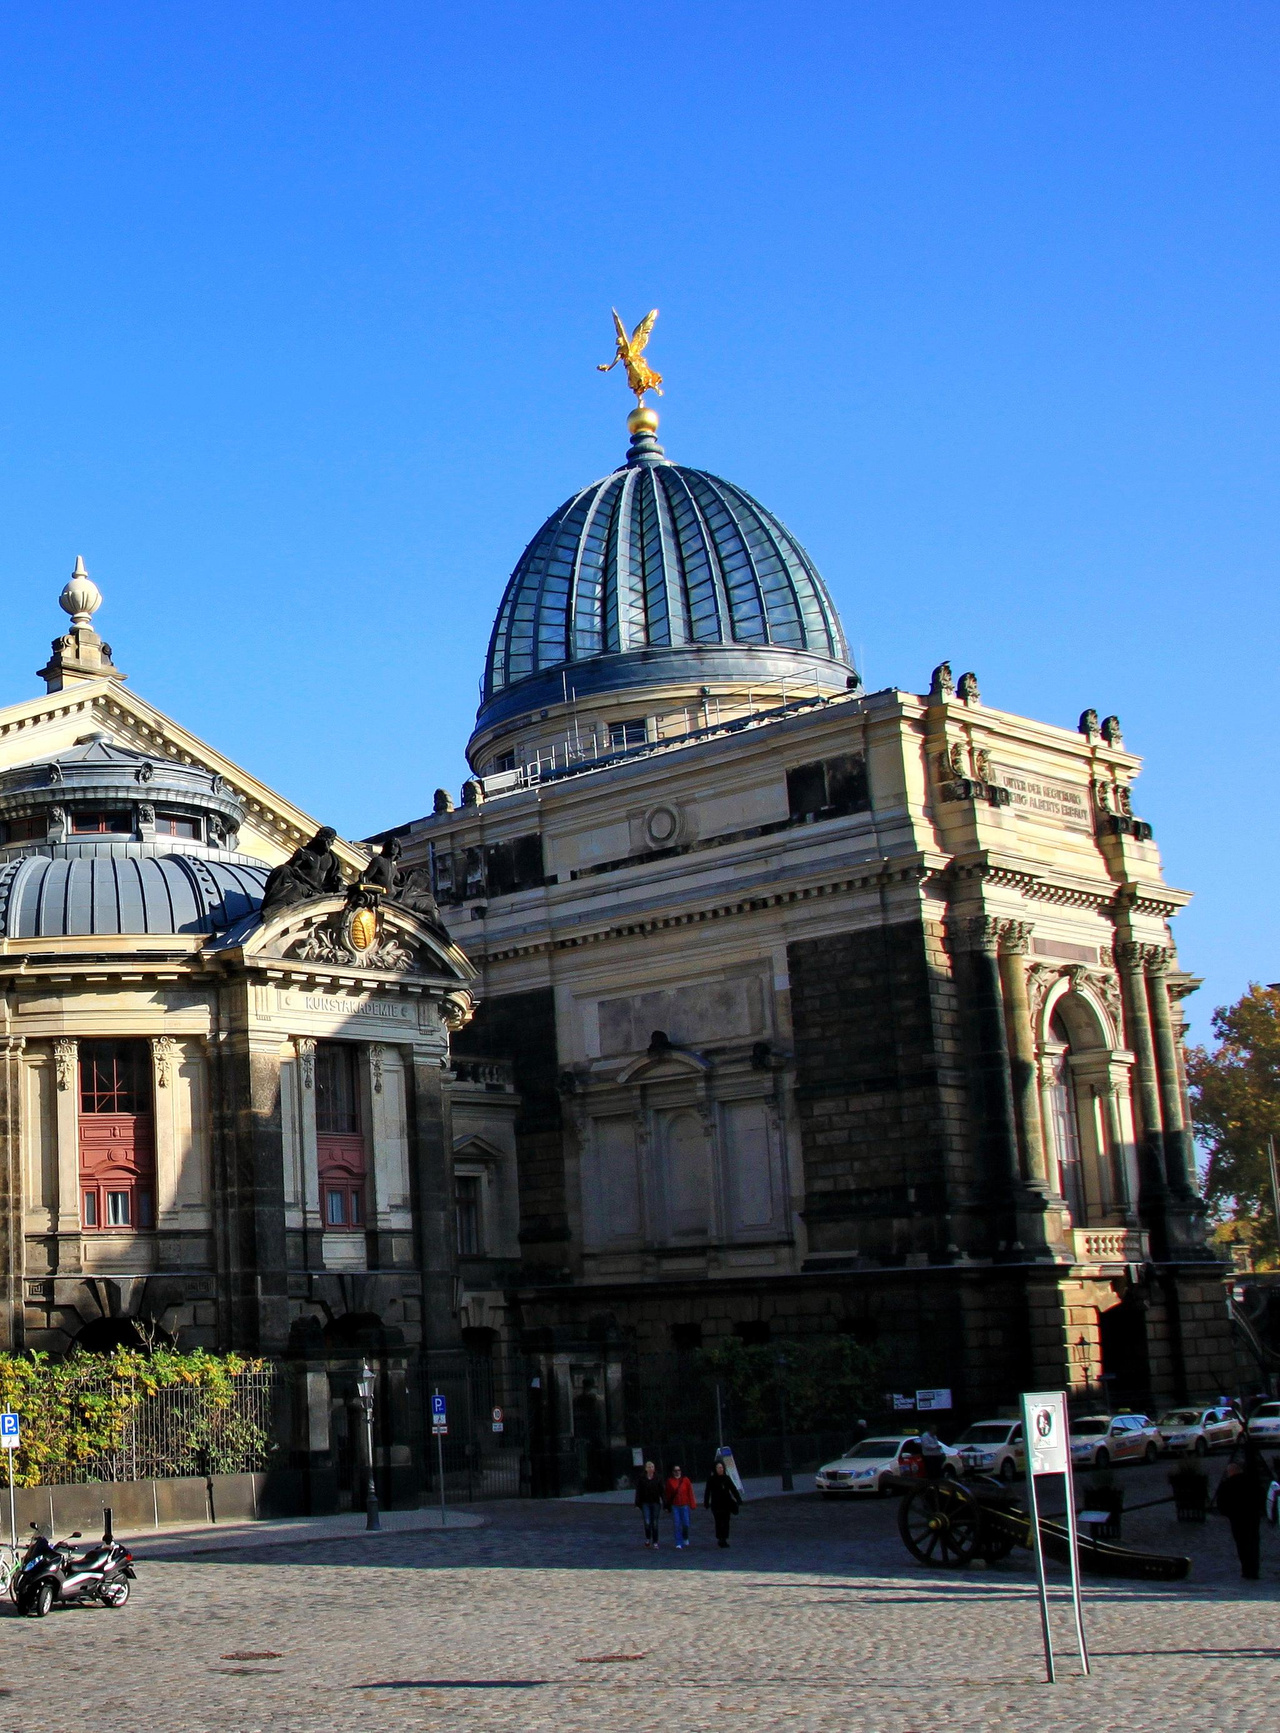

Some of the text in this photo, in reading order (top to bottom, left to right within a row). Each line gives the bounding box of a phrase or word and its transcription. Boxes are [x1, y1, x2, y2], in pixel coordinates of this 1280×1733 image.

[1003, 776, 1026, 791] UNTER
[1028, 782, 1042, 796] DER
[1029, 796, 1060, 814] ALBERTS
[1061, 805, 1088, 820] ERBAUT
[306, 996, 398, 1017] KUNSTAKADEMIE
[435, 1399, 442, 1412] P
[4, 1416, 15, 1433] P
